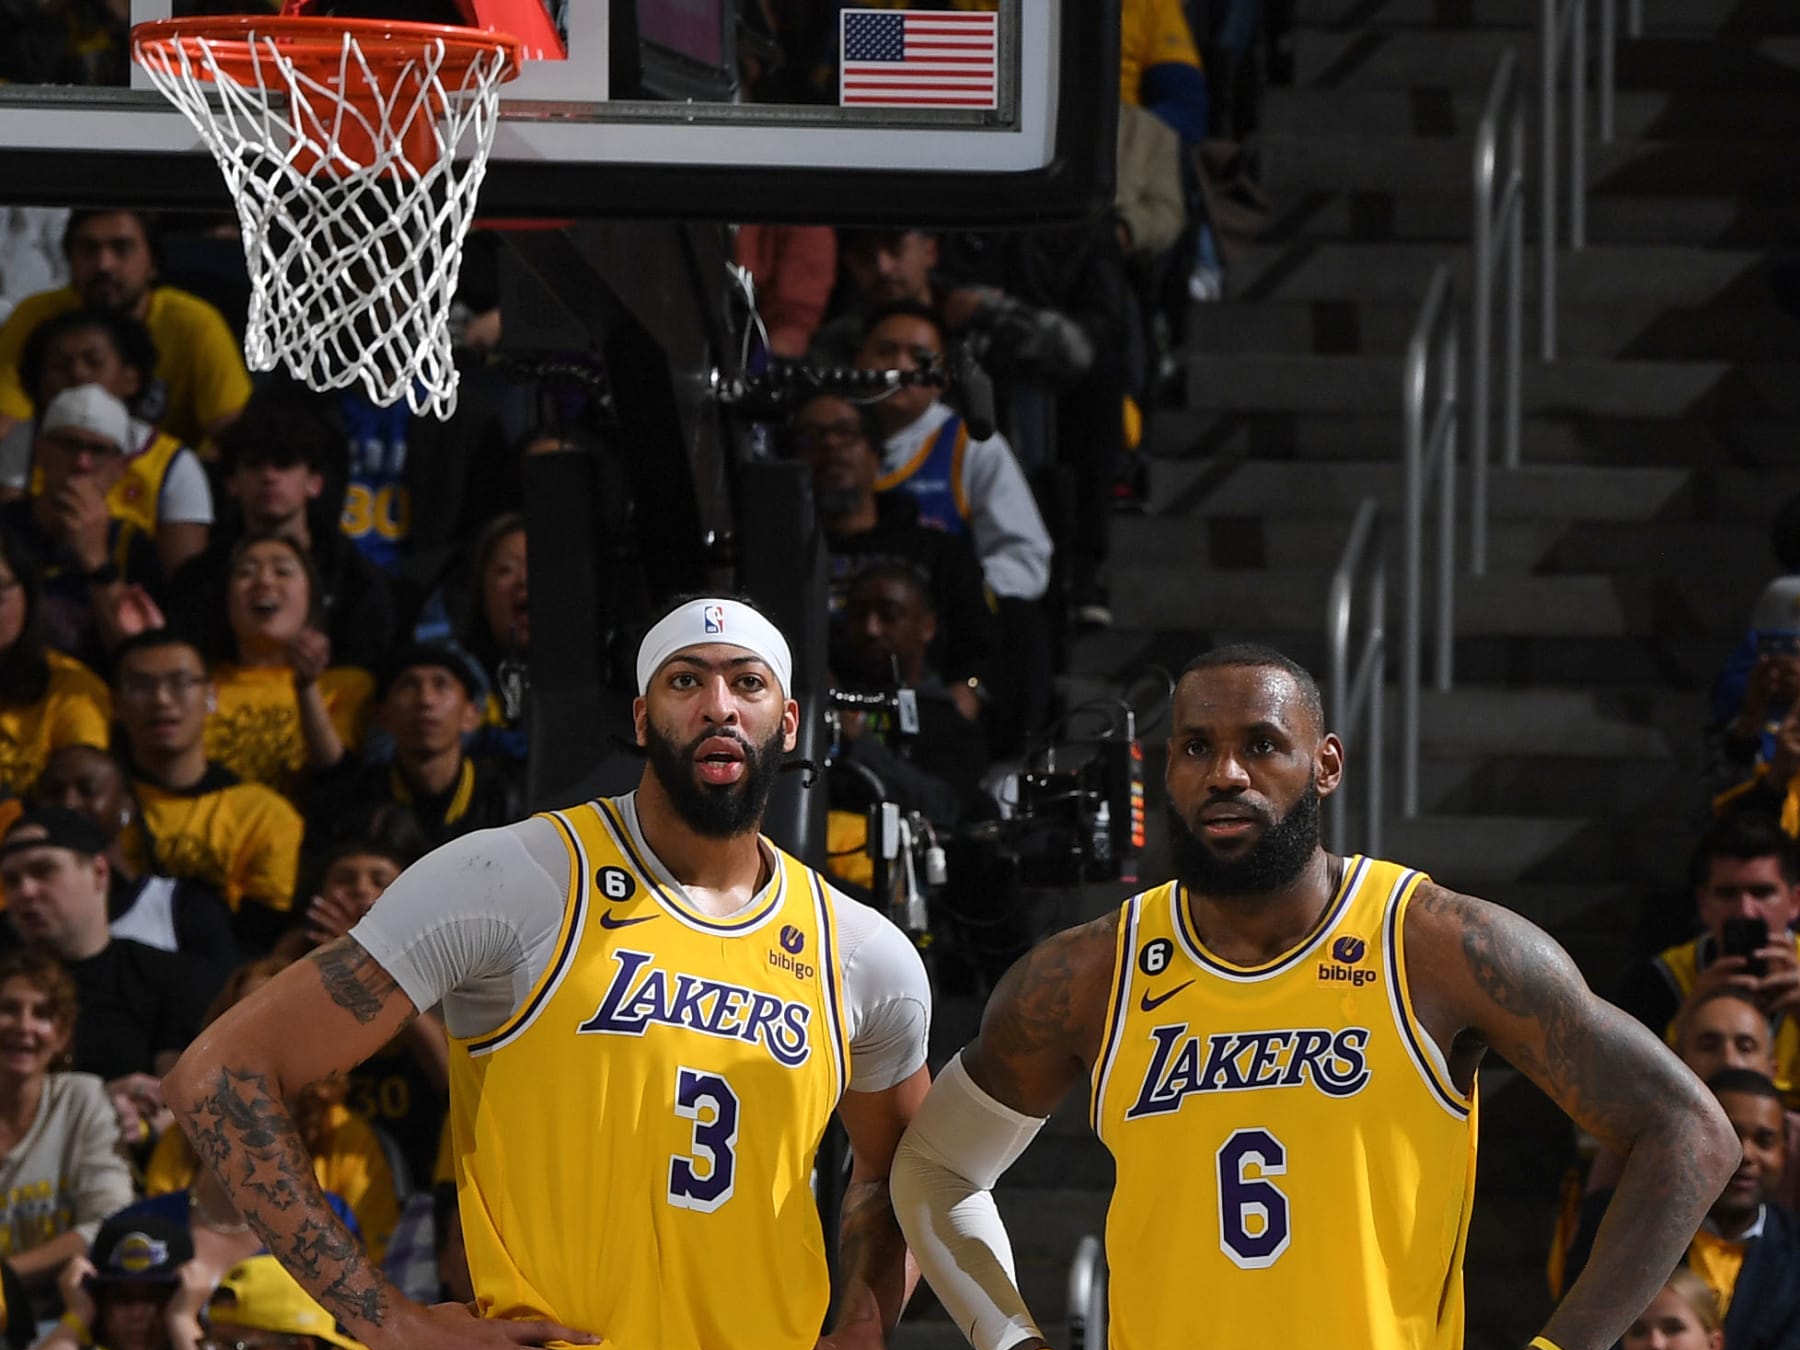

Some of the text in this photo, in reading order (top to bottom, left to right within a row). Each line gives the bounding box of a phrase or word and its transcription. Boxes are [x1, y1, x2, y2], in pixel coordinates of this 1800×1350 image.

[339, 483, 412, 541] 30
[606, 871, 627, 899] 6
[769, 949, 814, 980] bibigo
[1146, 944, 1166, 972] 6
[1319, 964, 1376, 987] bibigo
[576, 948, 812, 1068] LAKERS
[1124, 1022, 1372, 1122] LAKERS
[667, 1065, 740, 1214] 3
[1216, 1128, 1291, 1269] 6
